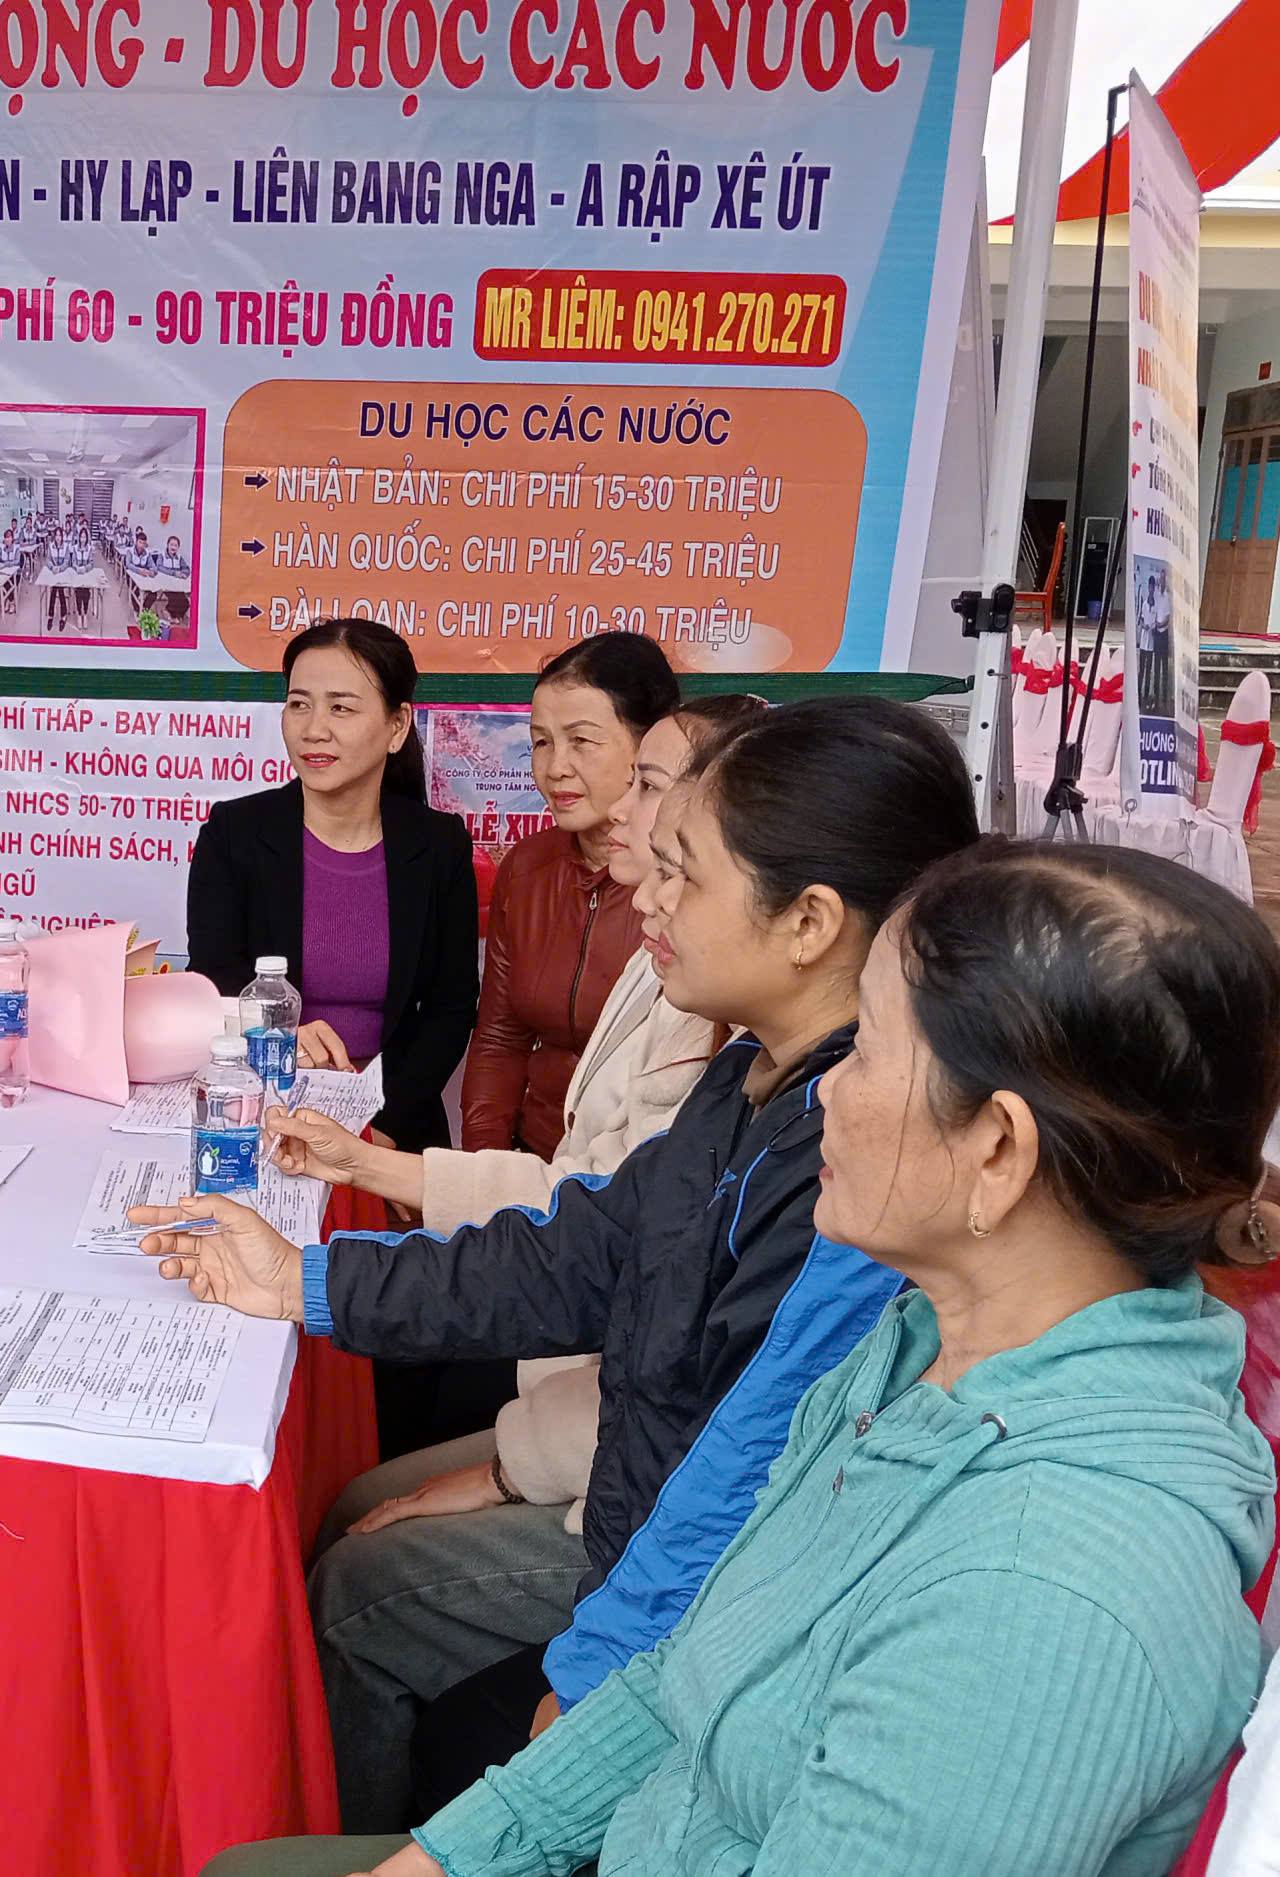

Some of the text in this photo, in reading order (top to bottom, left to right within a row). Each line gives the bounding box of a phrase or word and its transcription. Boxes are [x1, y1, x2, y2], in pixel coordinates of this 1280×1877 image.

[203, 0, 312, 89] DU
[331, 0, 489, 117] HỌC
[60, 160, 108, 221] HY
[121, 160, 191, 236] LẠP
[233, 147, 319, 223] LIÊN
[332, 160, 441, 224] BANG
[454, 161, 535, 226] NGA
[577, 163, 604, 227] A
[617, 150, 701, 242] RẬP
[711, 152, 766, 229] XÊ
[778, 152, 831, 230] ÚT
[68, 290, 115, 342] 60
[155, 291, 202, 344] 90
[216, 280, 328, 358] TRIỆU
[341, 273, 454, 347] ĐỒNG
[483, 275, 834, 354] MR LIÊM: 0941.270.271
[360, 396, 731, 447] DU HỌC CÁC NƯỚC
[276, 454, 782, 520] NHẬT BẢN: CHI PHÍ 15-30 TRIỆU
[273, 519, 781, 587] HÀN QUỐC: CHI PHÍ 25-45 TRIỆU
[437, 601, 491, 638] CHI
[501, 593, 560, 639] PHÍ
[565, 604, 646, 639] 10-30
[656, 598, 752, 650] TRIỆU
[32, 700, 93, 733] THẤP
[115, 711, 161, 737] BAY
[169, 713, 251, 739] NHANH
[65, 747, 148, 778] KHÔNG
[156, 755, 204, 780] QUA
[211, 752, 253, 782] MÔI
[6, 790, 69, 816] NHCS
[78, 794, 135, 819] 50-70
[141, 792, 210, 827] TRIỆU
[30, 829, 101, 859] CHÍNH
[109, 832, 178, 866] SÁCH,
